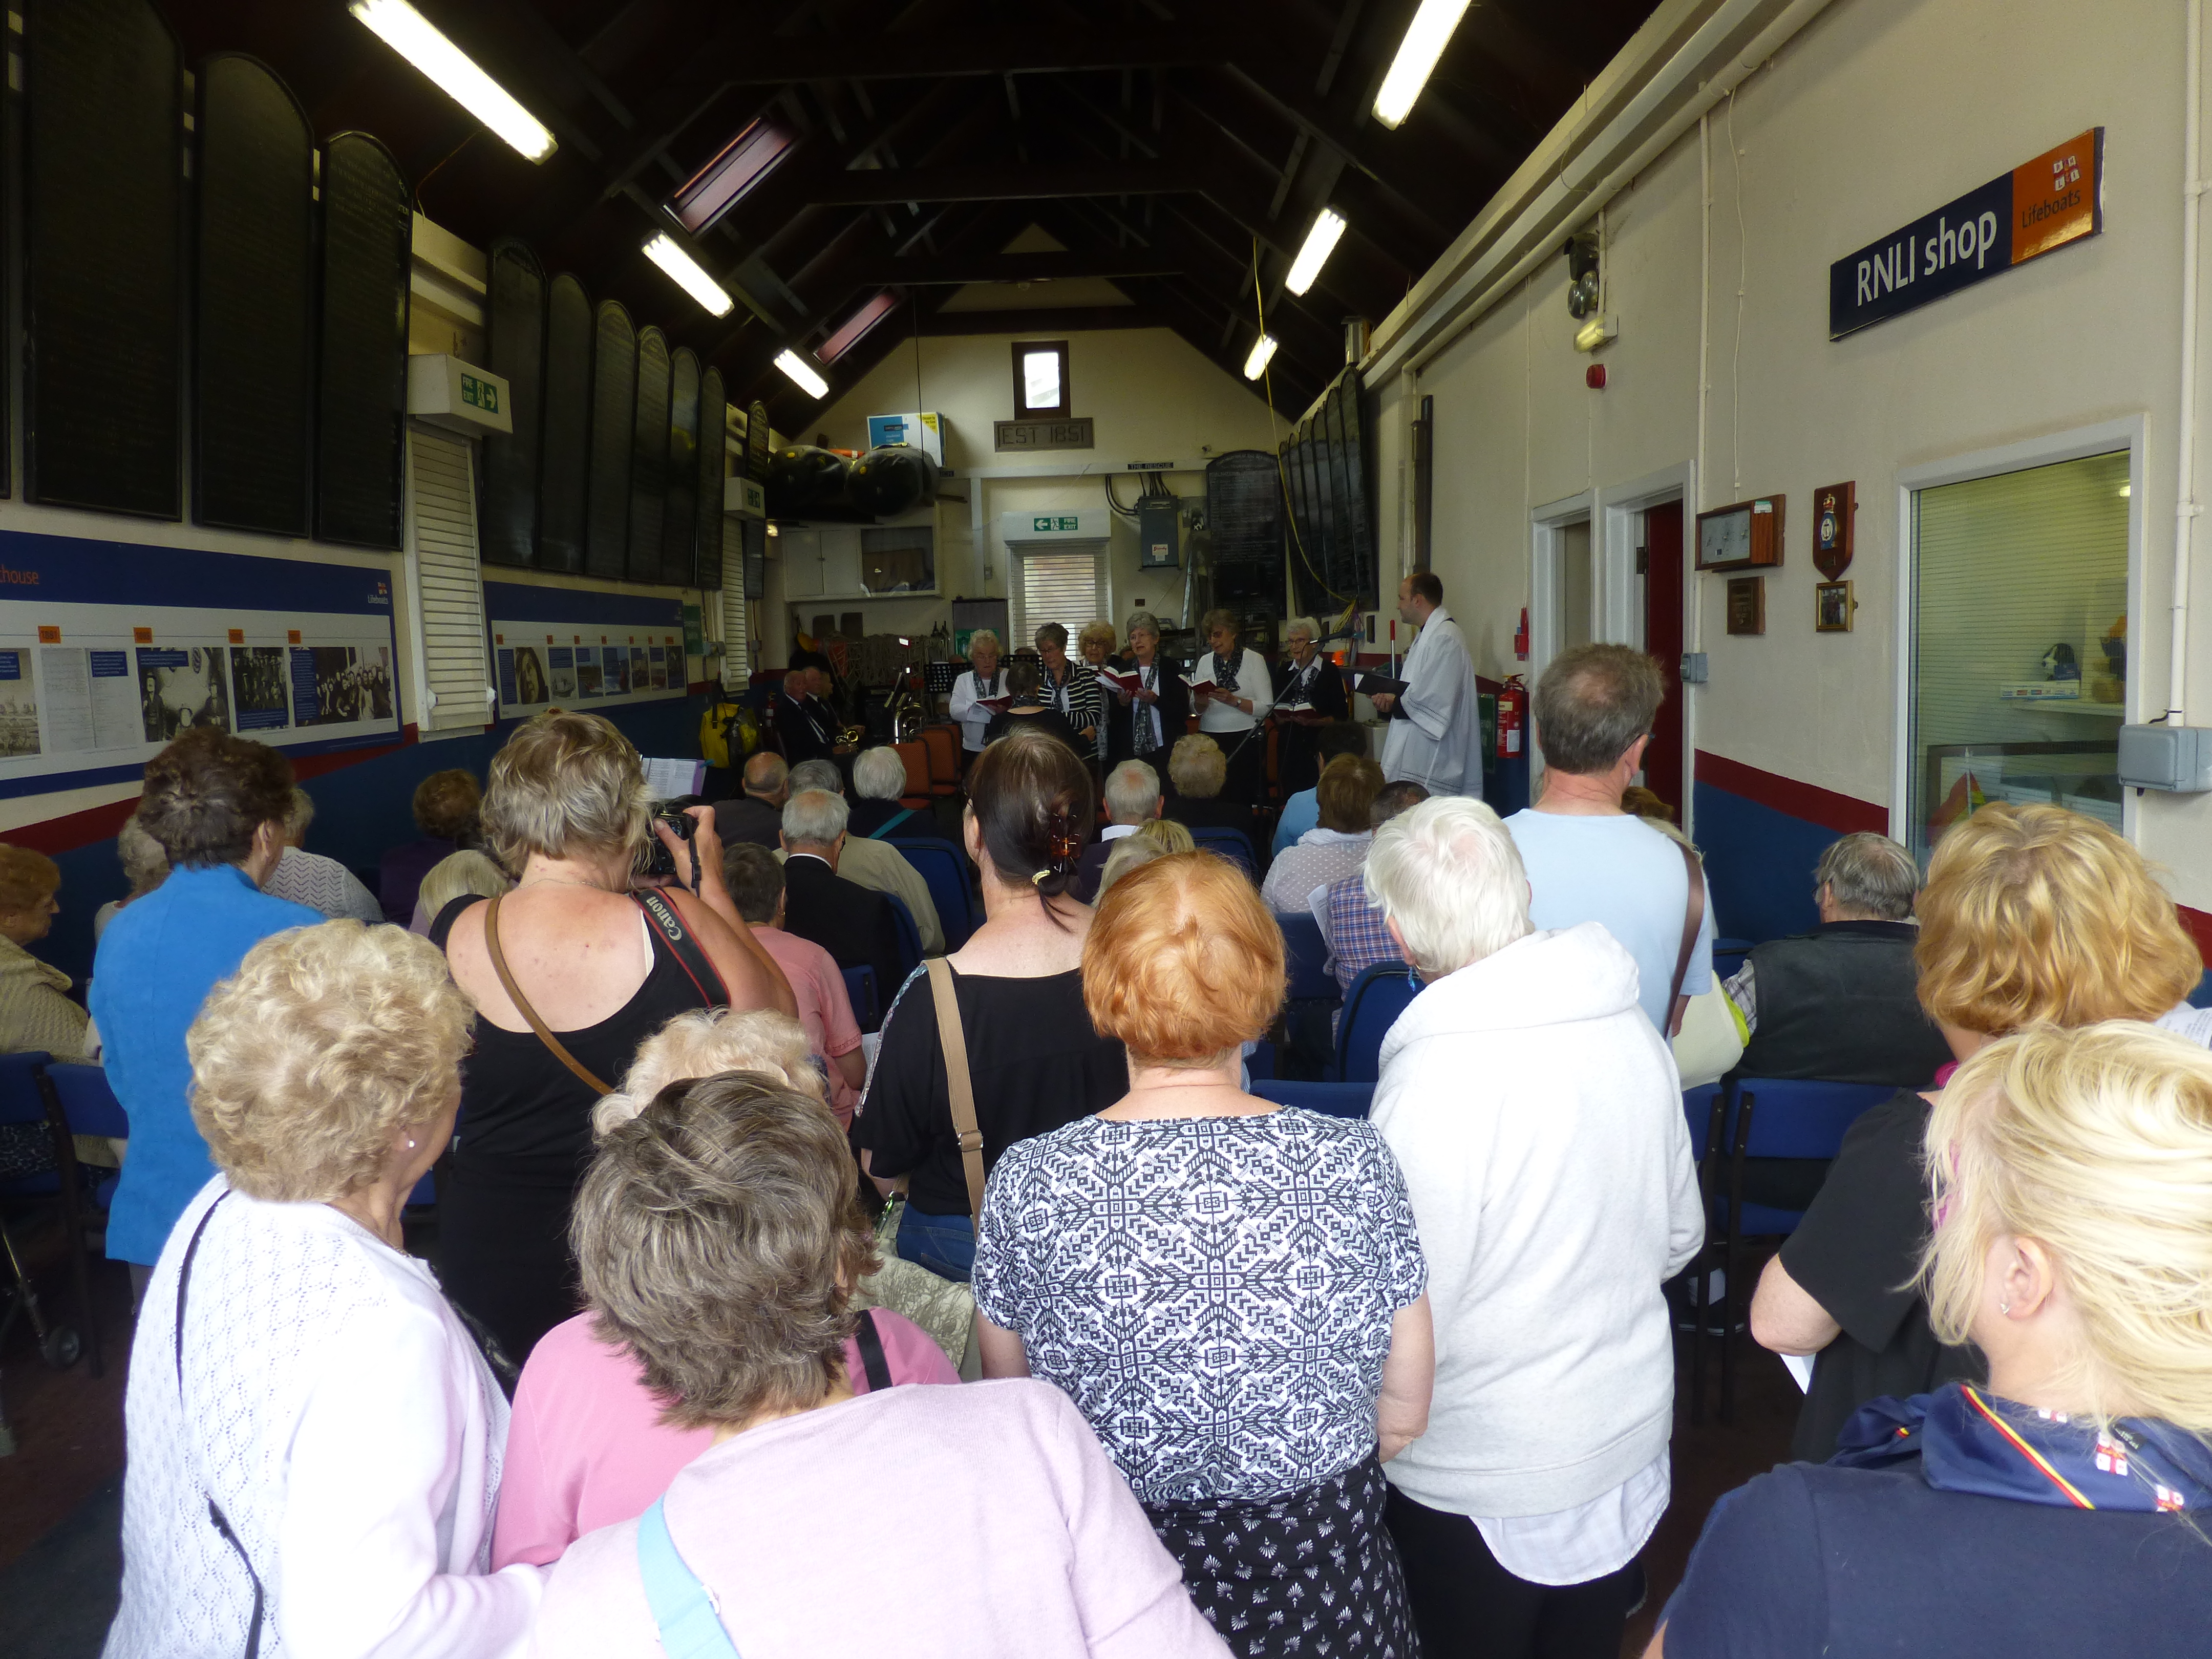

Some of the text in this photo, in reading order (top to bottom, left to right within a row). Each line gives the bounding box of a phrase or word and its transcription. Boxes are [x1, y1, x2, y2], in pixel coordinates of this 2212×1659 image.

[2022, 188, 2081, 228] Lifeboats
[1857, 210, 1997, 307] RNLI shop
[463, 376, 473, 389] FIRE
[463, 390, 474, 402] EXIT
[1002, 427, 1039, 444] EST
[646, 896, 682, 941] Canon
